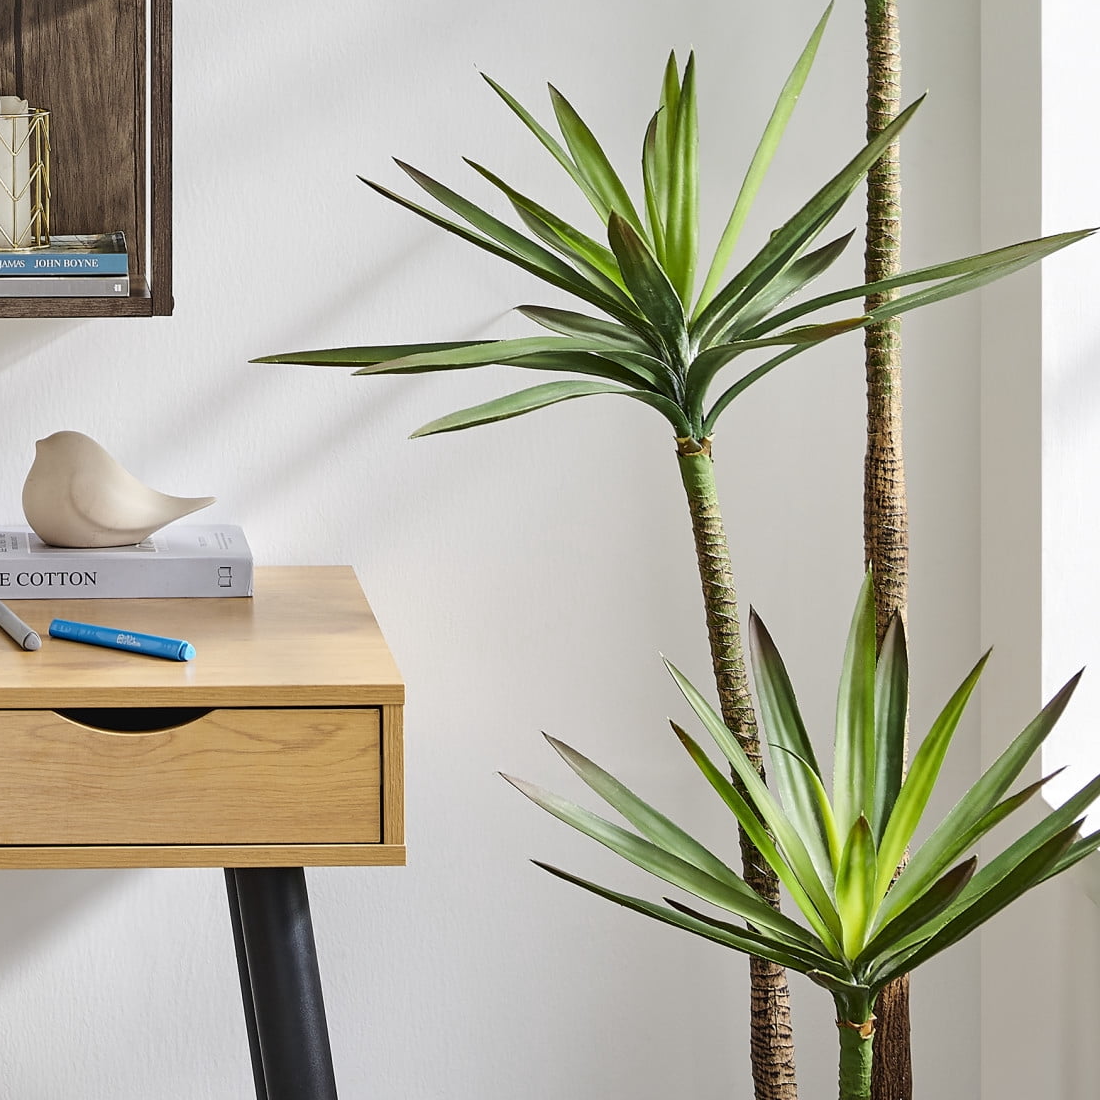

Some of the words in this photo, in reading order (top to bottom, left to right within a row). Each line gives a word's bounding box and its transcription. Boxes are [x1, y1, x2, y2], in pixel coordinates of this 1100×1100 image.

[34, 259, 61, 269] JOHN
[63, 258, 99, 268] BOYNE
[16, 571, 98, 587] COTTON
